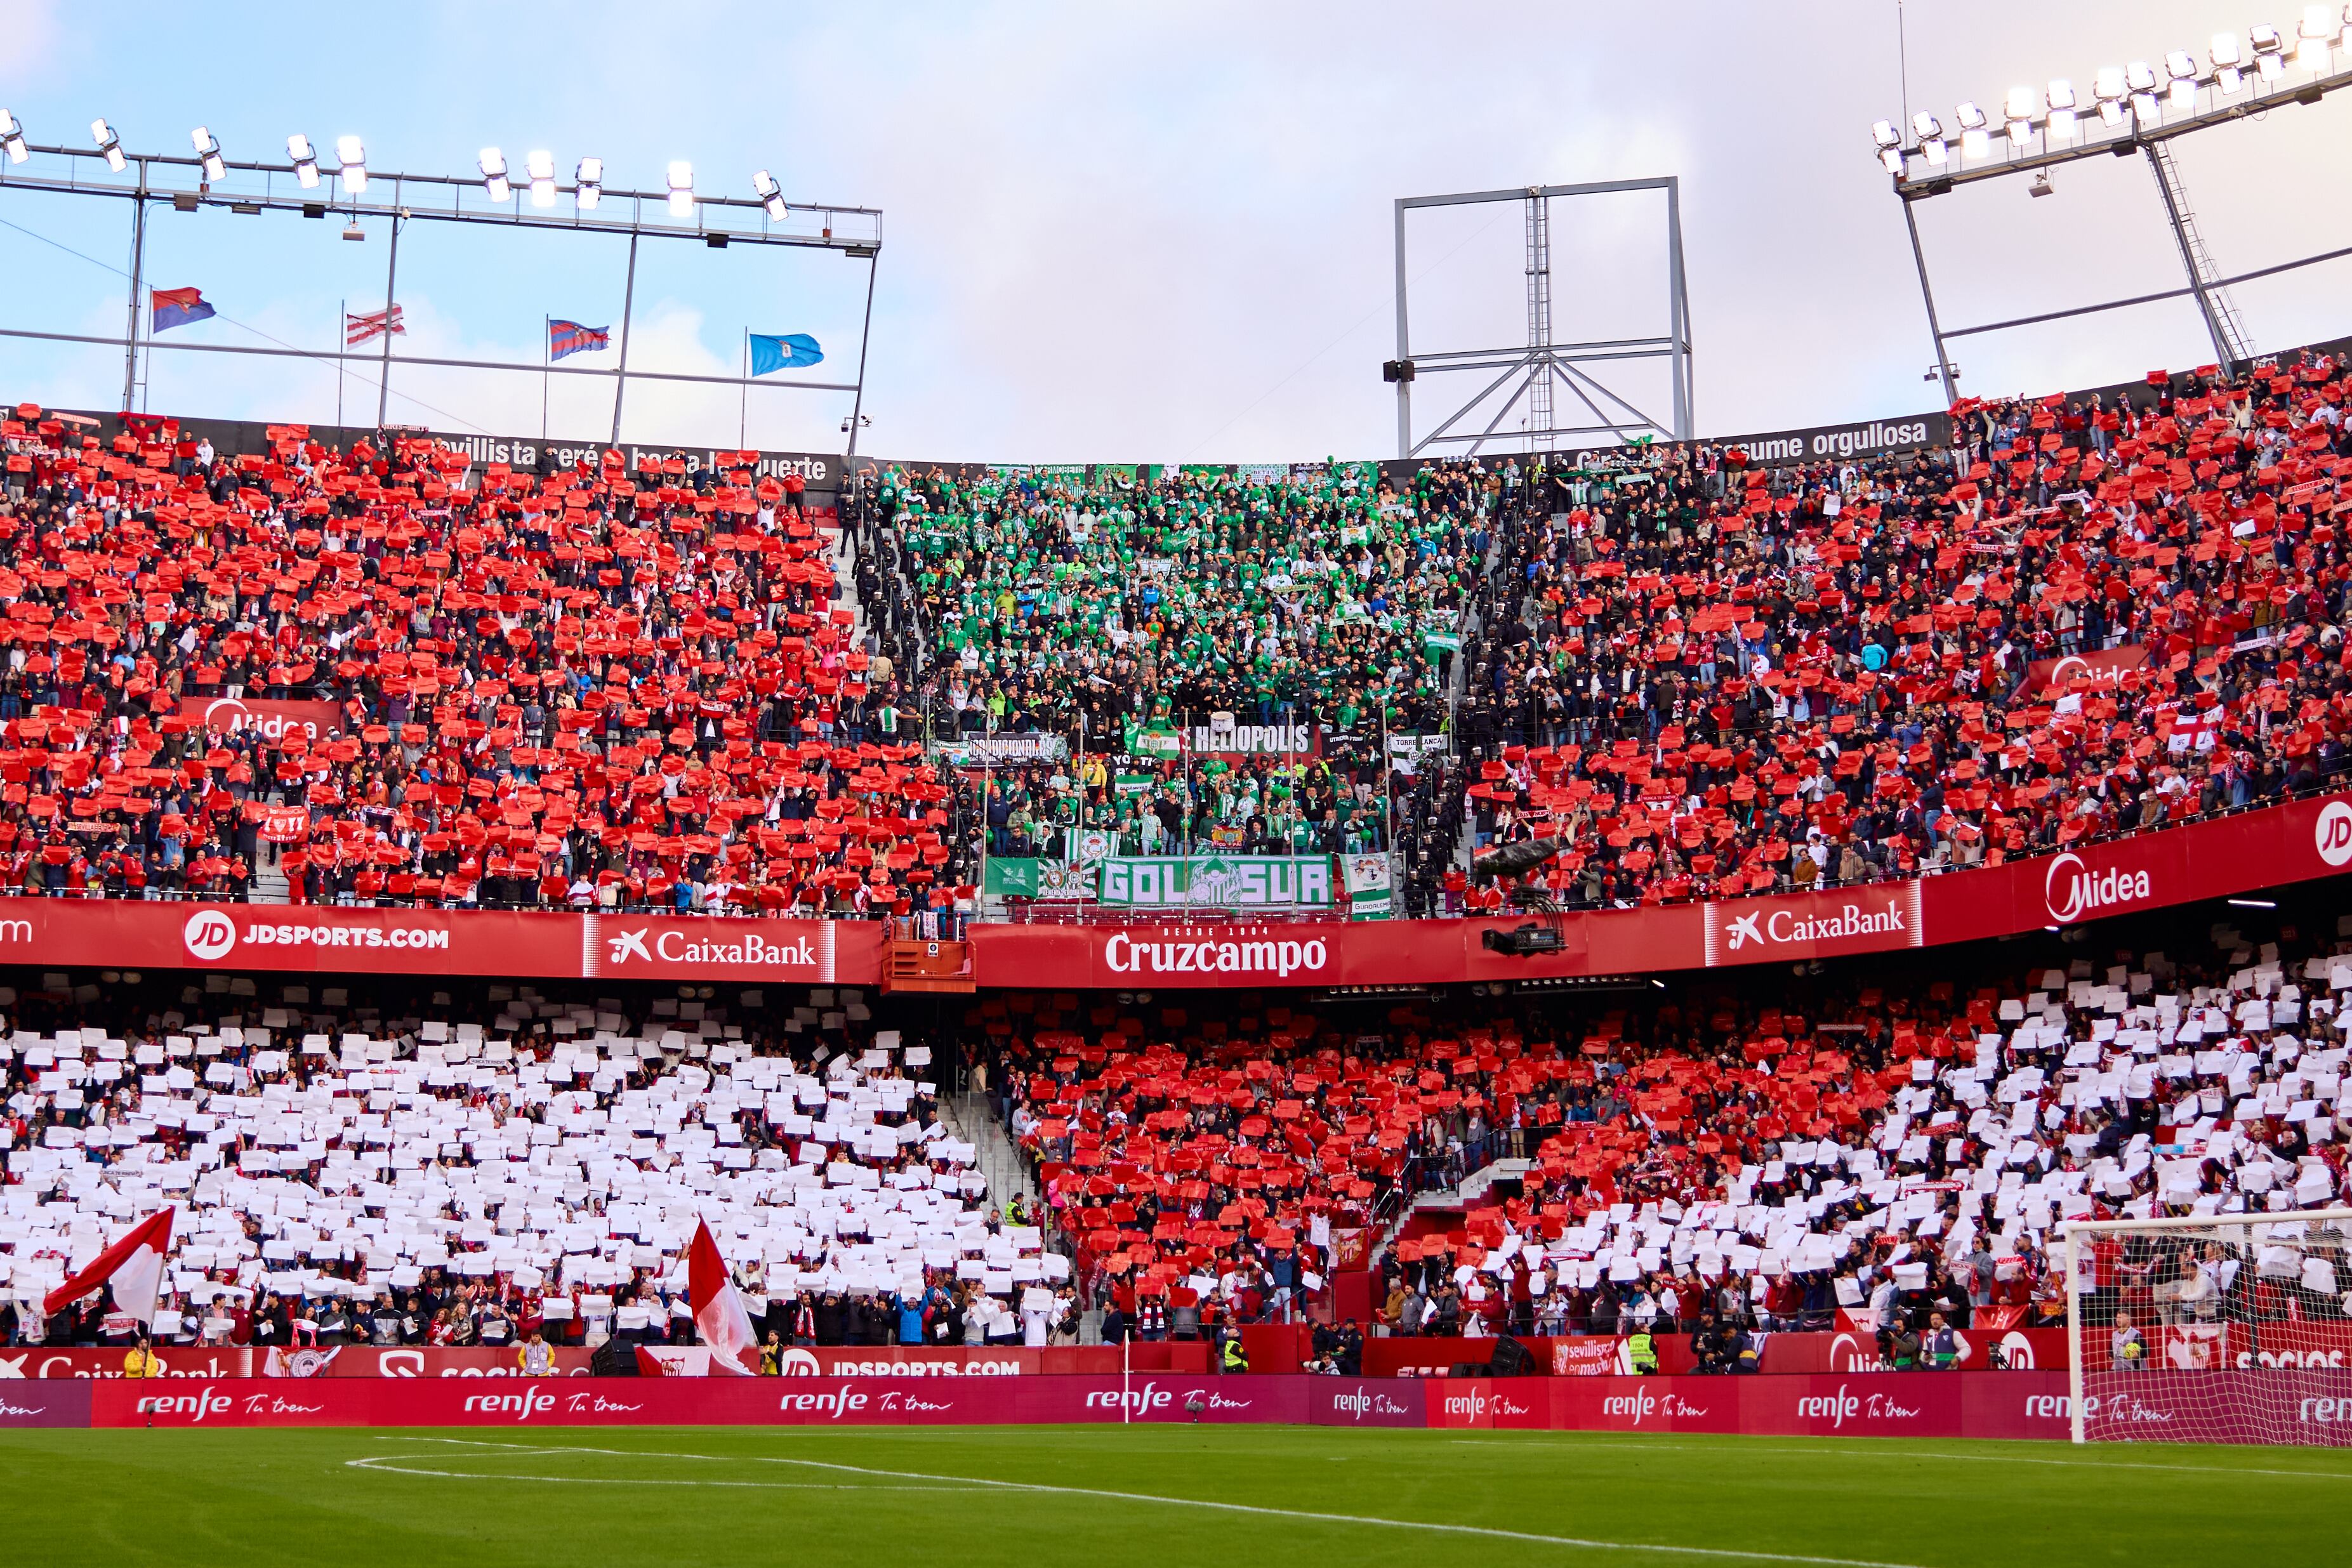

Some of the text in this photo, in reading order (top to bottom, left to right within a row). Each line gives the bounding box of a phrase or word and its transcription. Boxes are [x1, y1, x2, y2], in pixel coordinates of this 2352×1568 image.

[1813, 423, 1926, 456] orgullosa
[969, 739, 1054, 757] NCONDICIONALES
[1196, 725, 1309, 753] HELIOPOLIS
[2322, 817, 2351, 852] JD
[1104, 864, 1185, 904] GOL
[1244, 863, 1329, 903] SUR
[2061, 867, 2150, 914] Midea
[192, 923, 228, 947] JD
[243, 925, 449, 949] JDSPORTS.COM
[1165, 927, 1269, 936] DESDE 1904
[1769, 900, 1905, 942] CaixaBank
[657, 932, 817, 965] CaixaBank
[1106, 931, 1326, 977] Cruzcampo
[40, 1357, 228, 1378] CaixBank
[138, 1387, 232, 1421] renfe
[465, 1385, 555, 1420] renfe
[781, 1385, 868, 1418] renfe
[1087, 1381, 1172, 1416] renfe
[1335, 1386, 1371, 1420] renfe
[1446, 1387, 1485, 1423] renfe
[1604, 1385, 1655, 1425] renfe
[1799, 1384, 1860, 1428] renfe
[2025, 1395, 2099, 1430] rene
